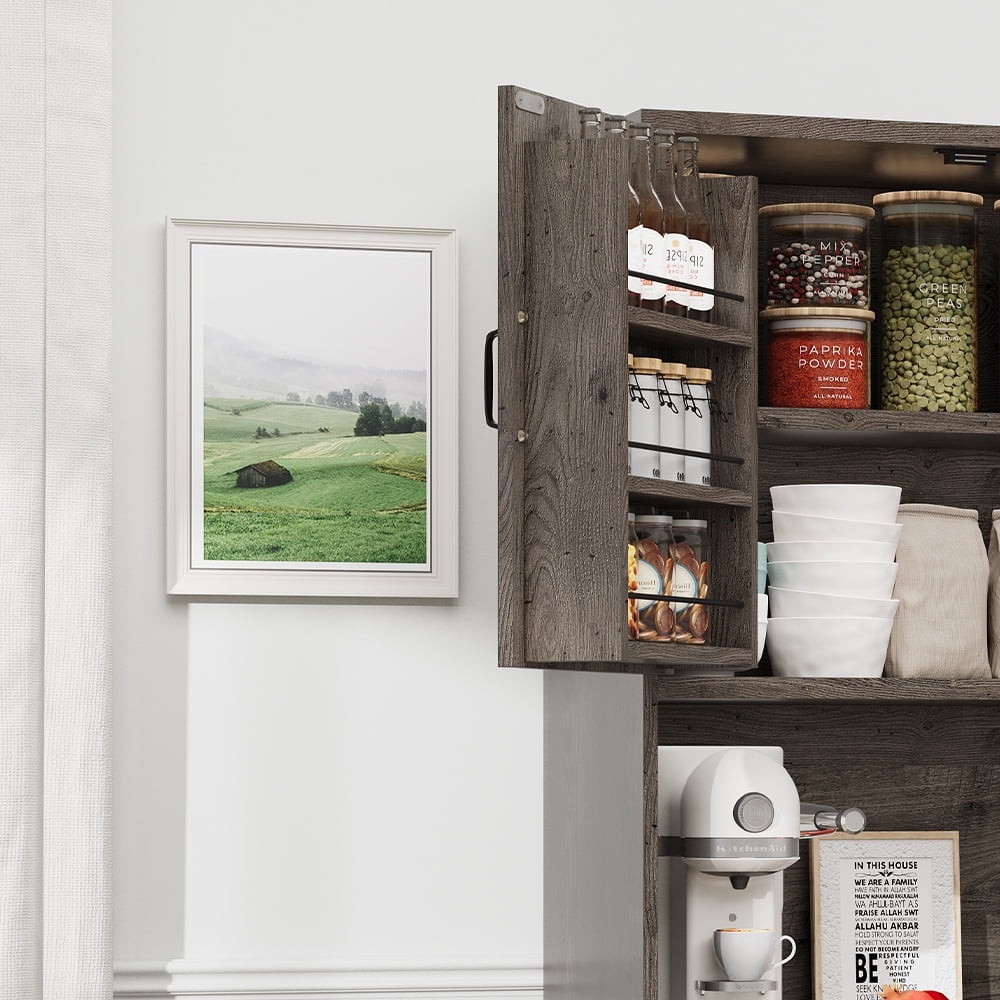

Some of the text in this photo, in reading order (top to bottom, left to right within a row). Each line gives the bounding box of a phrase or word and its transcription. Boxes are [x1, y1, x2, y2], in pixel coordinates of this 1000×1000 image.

[820, 241, 847, 251] MIX
[802, 255, 860, 266] PEPPER
[918, 282, 966, 294] GREEN
[926, 298, 962, 308] PEAS
[799, 346, 863, 356] PAPRIKA
[798, 358, 863, 370] POWDER
[854, 862, 918, 870] IN THIS HOUSE
[855, 922, 919, 930] ALLAHU AKBAR
[856, 953, 878, 984] BE
[856, 985, 872, 993] SEEK
